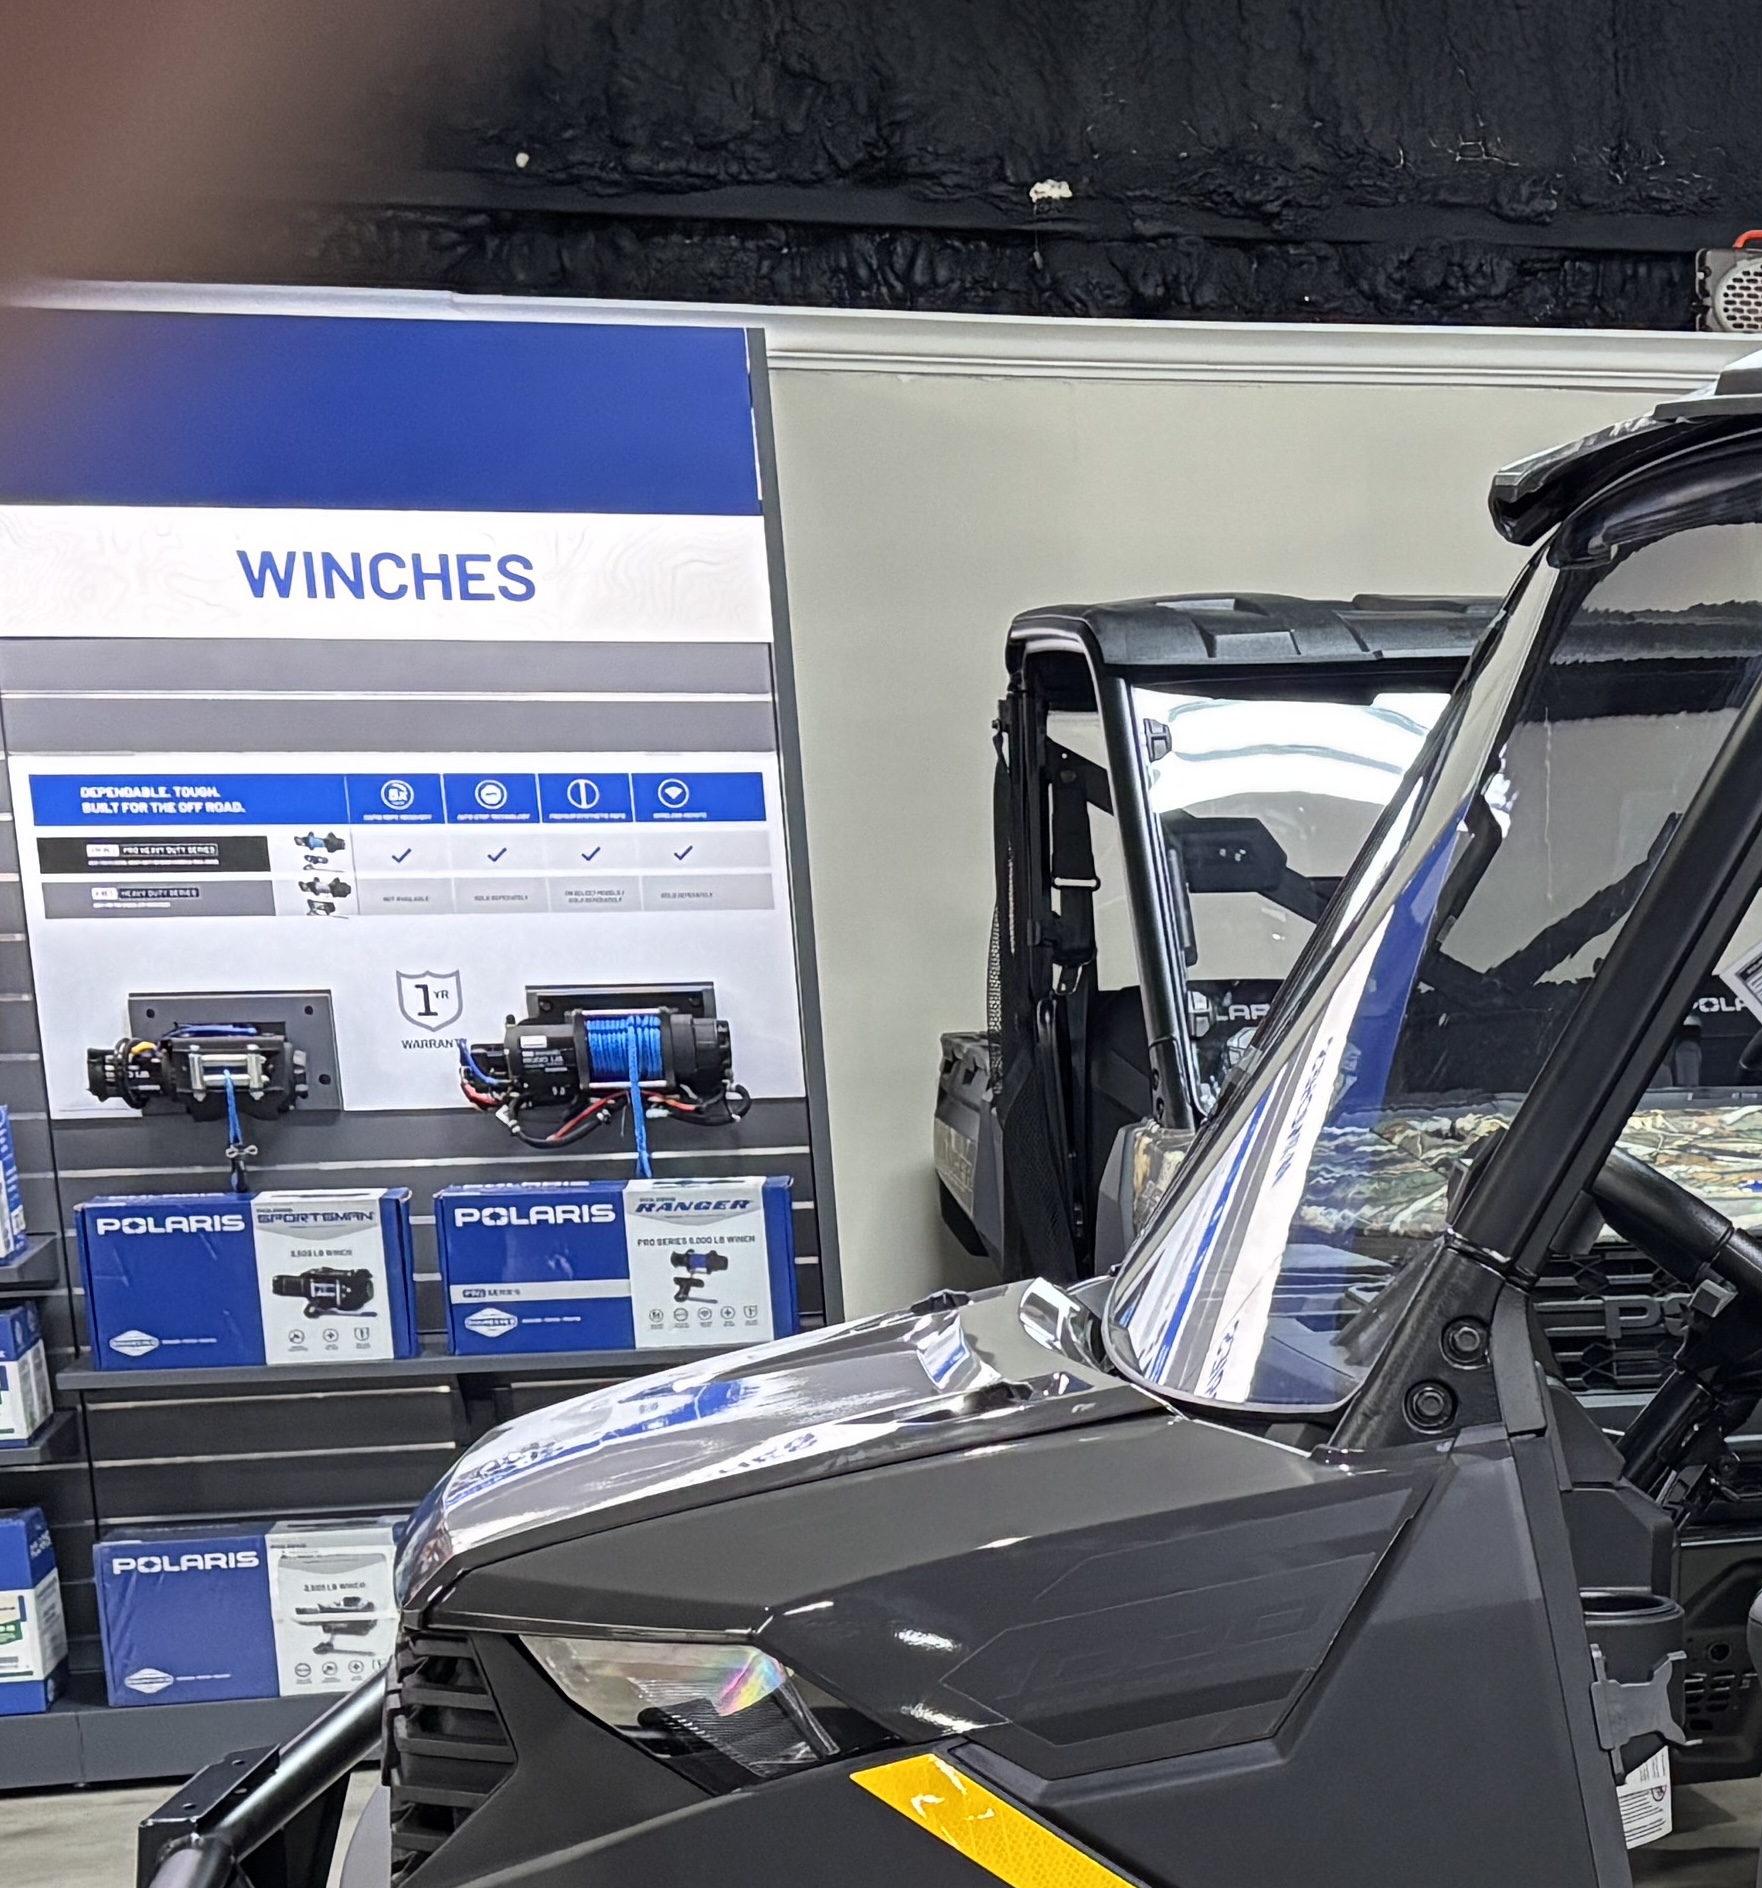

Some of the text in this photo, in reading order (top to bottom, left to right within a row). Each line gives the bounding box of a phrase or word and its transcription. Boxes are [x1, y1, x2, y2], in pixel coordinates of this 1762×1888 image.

[236, 550, 536, 602] WINCHES
[122, 802, 148, 814] FOR
[151, 802, 176, 813] THE
[178, 801, 203, 813] OFF
[414, 984, 449, 1017] 1 YR
[454, 1203, 616, 1227] POLARIS
[635, 1199, 753, 1212] RANGER
[96, 1214, 245, 1235] POLARIS
[112, 1551, 260, 1575] POLARIS
